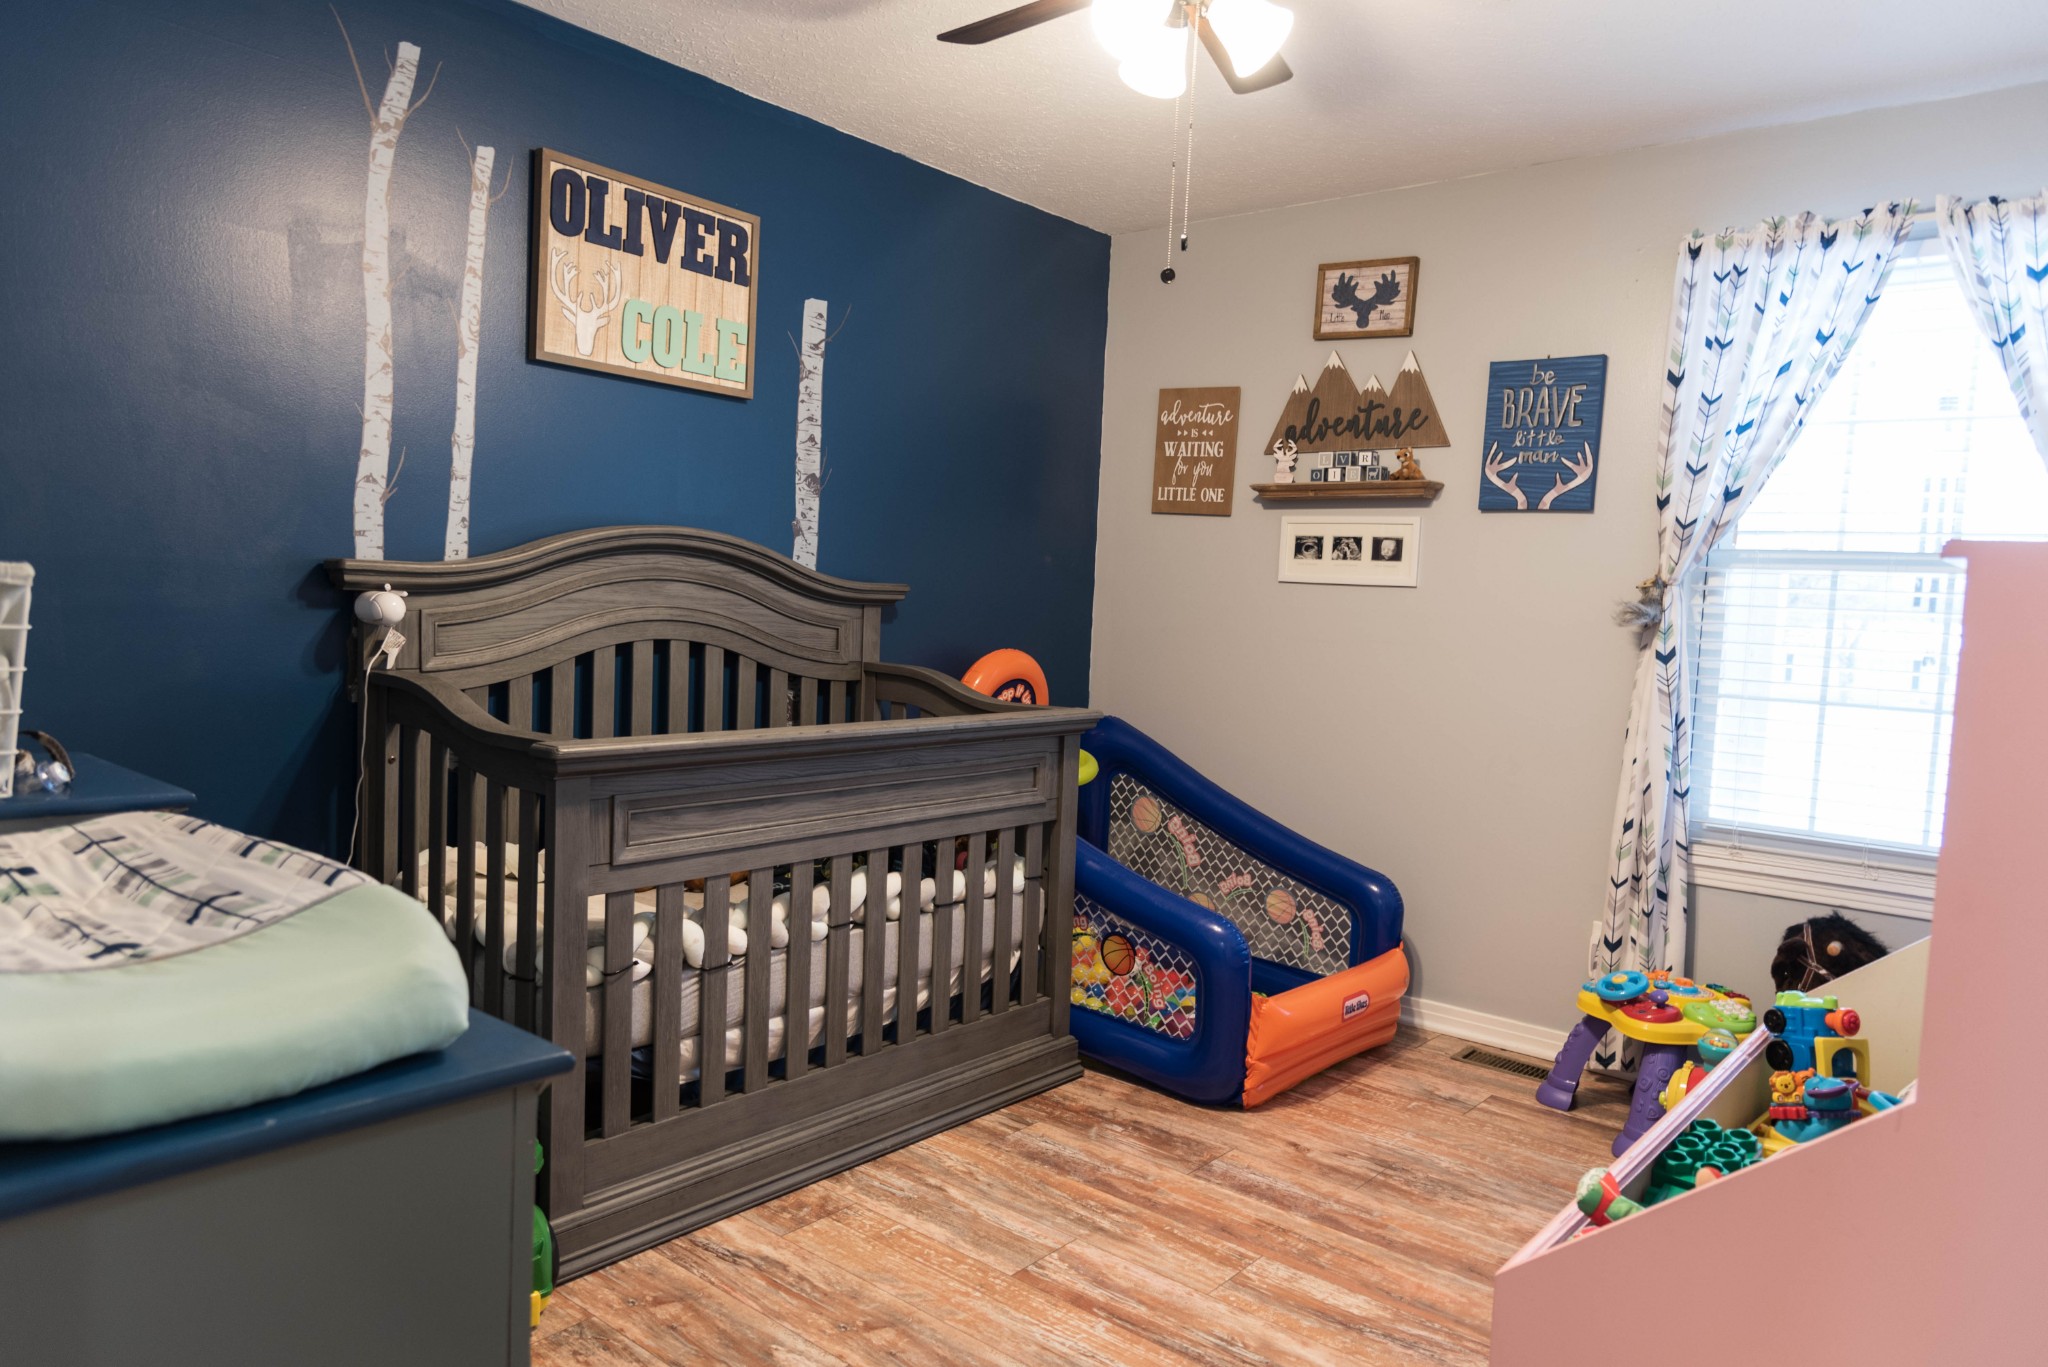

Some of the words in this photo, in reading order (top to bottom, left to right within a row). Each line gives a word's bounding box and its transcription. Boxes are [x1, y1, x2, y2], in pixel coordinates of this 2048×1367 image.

[550, 168, 750, 287] OLIVER
[621, 298, 748, 383] COLE
[1529, 363, 1558, 386] be
[1160, 400, 1234, 426] adventure
[1501, 384, 1588, 430] BRAVE
[1190, 428, 1199, 438] IS
[1285, 397, 1429, 446] adventure
[1164, 441, 1224, 457] WAITING
[1512, 429, 1566, 448] little
[1171, 454, 1189, 485] for
[1192, 461, 1213, 487] you
[1517, 450, 1560, 465] man
[1157, 486, 1197, 501] LITTLE
[1200, 488, 1225, 502] ONE
[1142, 962, 1166, 1009] Boing
